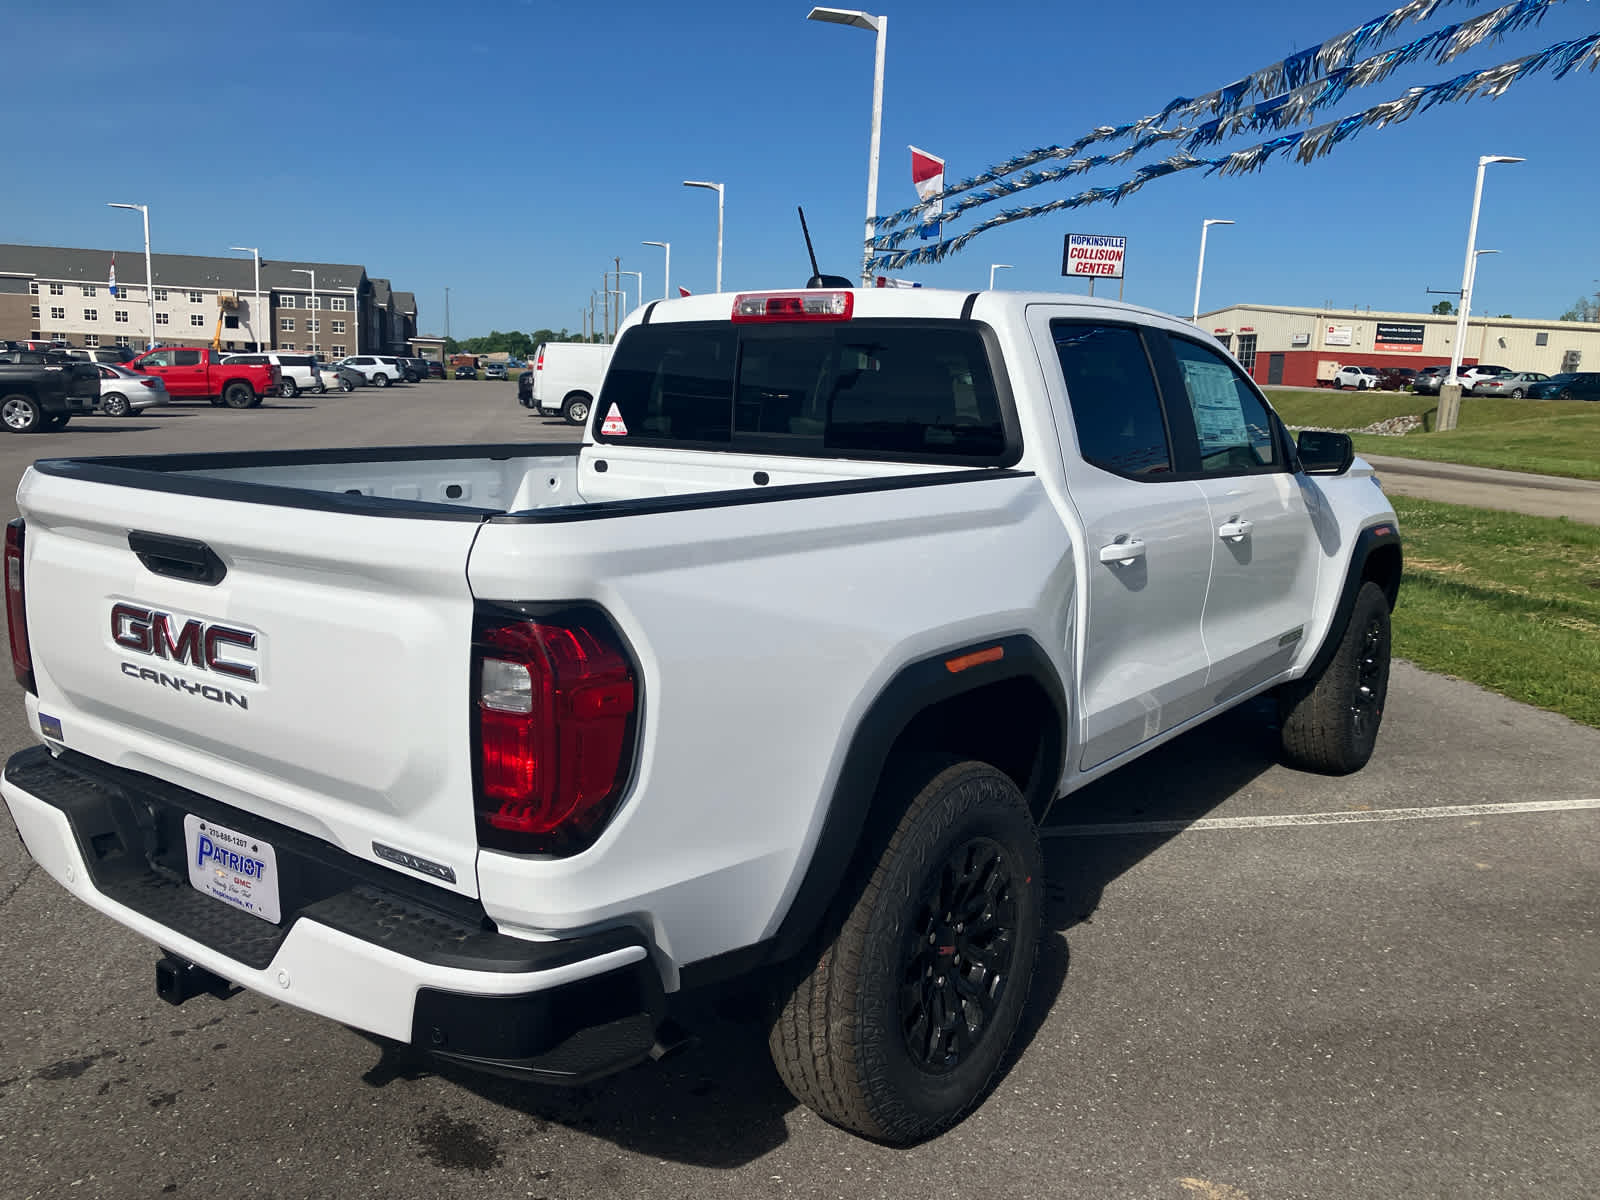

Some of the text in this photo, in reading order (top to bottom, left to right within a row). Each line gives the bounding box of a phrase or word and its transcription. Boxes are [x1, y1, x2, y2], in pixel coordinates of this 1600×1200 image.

[1072, 236, 1123, 247] HOPKINSVILLE
[1071, 248, 1122, 261] COLLISION
[1075, 262, 1115, 274] CENTER
[110, 601, 259, 684] GMC
[121, 662, 249, 710] CANYON
[234, 877, 251, 888] GMC
